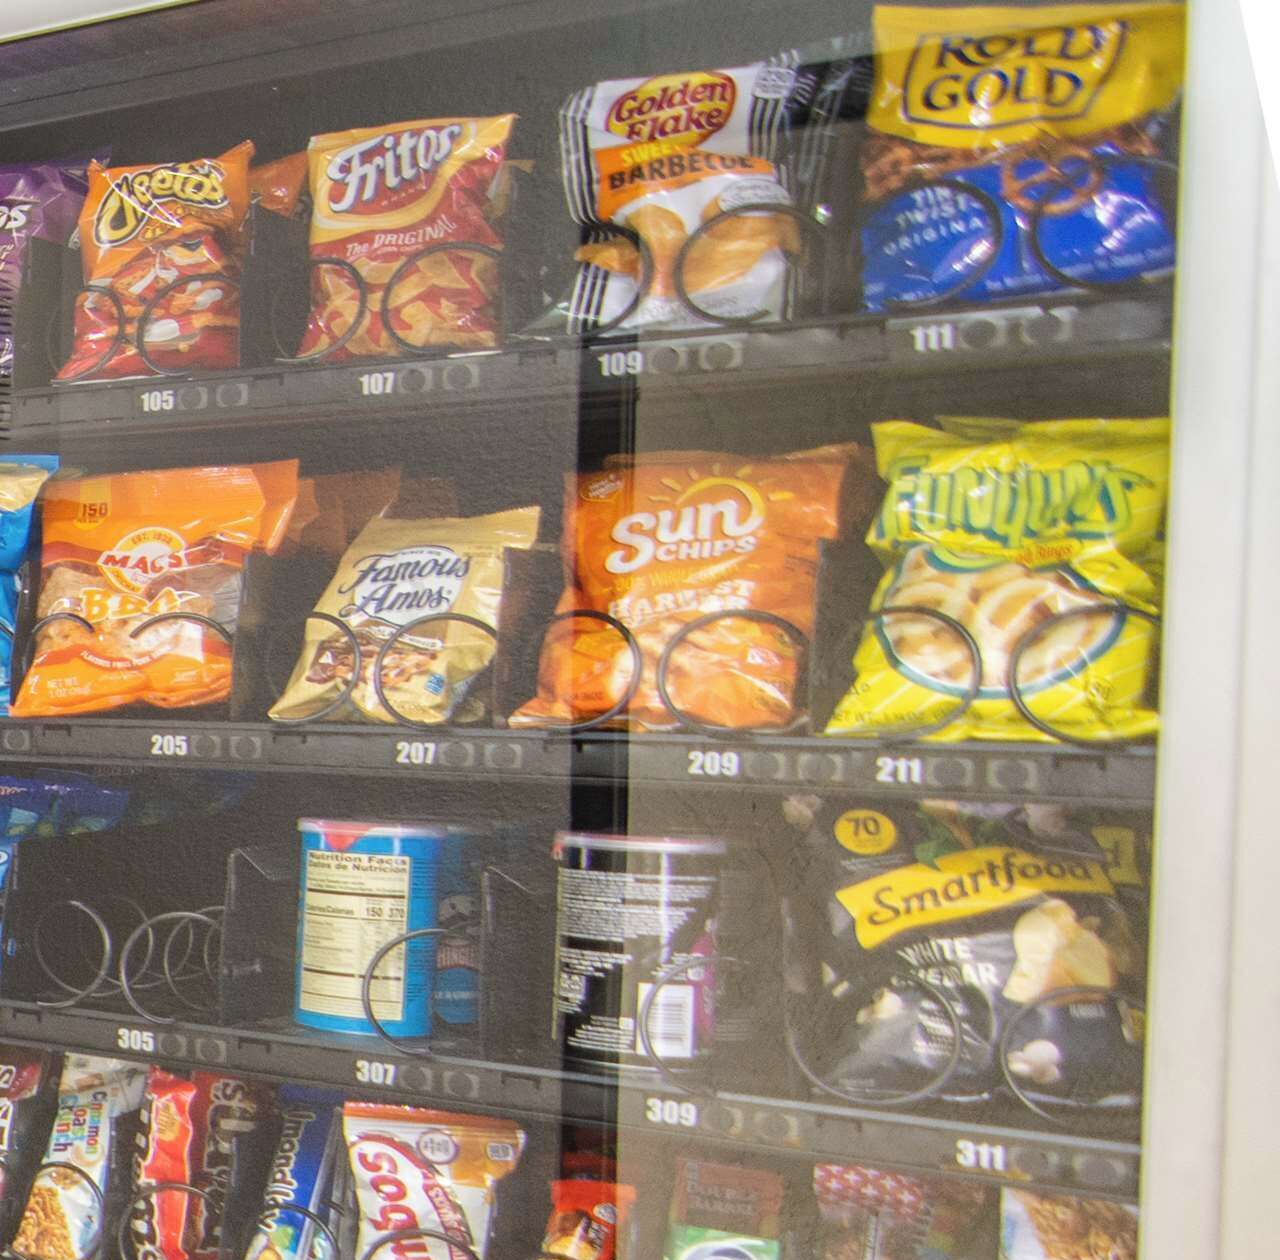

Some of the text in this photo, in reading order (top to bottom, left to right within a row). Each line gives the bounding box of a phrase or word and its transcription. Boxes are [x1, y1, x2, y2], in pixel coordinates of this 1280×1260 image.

[614, 82, 729, 124] Golden
[923, 69, 1082, 111] GOLD
[626, 106, 725, 143] Flake
[327, 123, 462, 213] Fritos
[911, 323, 955, 351] 111
[598, 351, 643, 377] 109
[359, 372, 395, 396] 107
[140, 390, 174, 412] 105
[81, 503, 109, 517] 150
[604, 500, 763, 574] Sun
[655, 535, 757, 562] CHIPS
[338, 554, 473, 594] Famous
[338, 584, 450, 617] Amos
[150, 735, 188, 757] 205
[395, 741, 437, 765] 207
[687, 751, 741, 776] 209
[875, 757, 924, 784] 211
[845, 816, 881, 837] 70
[309, 852, 407, 866] Nutrition Facts
[868, 853, 1093, 927] Smartfood
[366, 908, 383, 918] 150
[895, 937, 972, 964] WHITE
[117, 1028, 154, 1052] 305
[356, 1060, 396, 1085] 307
[645, 1097, 698, 1127] 309
[955, 1139, 1007, 1171] 311
